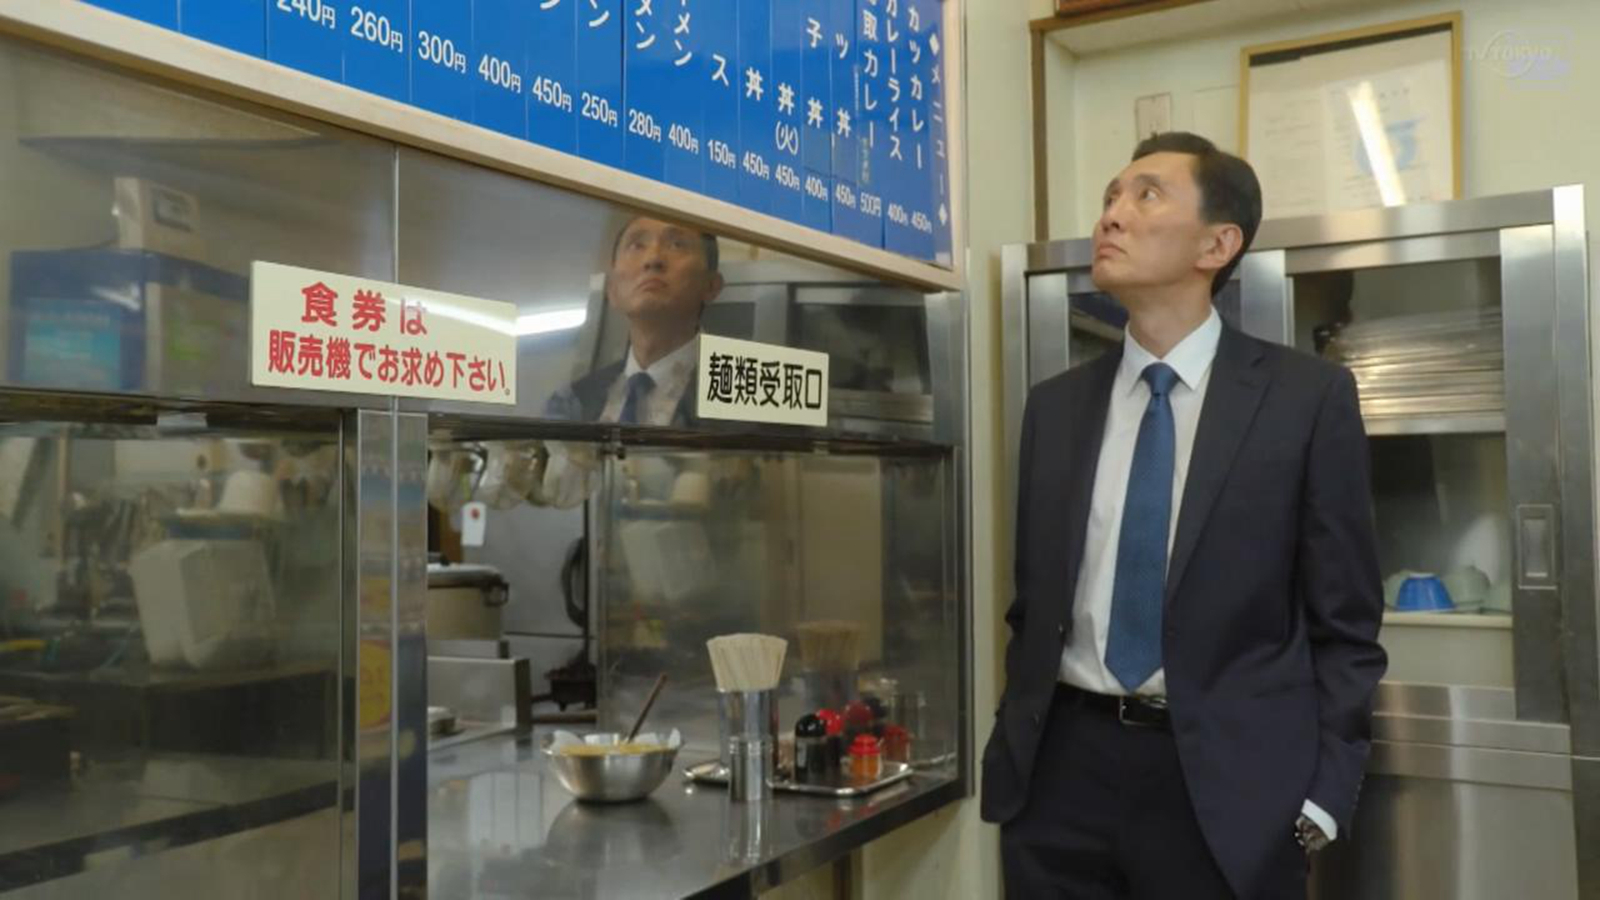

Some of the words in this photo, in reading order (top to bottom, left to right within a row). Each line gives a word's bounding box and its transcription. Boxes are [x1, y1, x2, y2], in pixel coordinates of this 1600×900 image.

[350, 6, 403, 53] 260円
[674, 0, 693, 67] メン
[418, 30, 467, 75] 300円
[478, 54, 521, 95] 400円
[712, 53, 730, 87] ス
[863, 0, 879, 148] 取カレー
[532, 75, 573, 113] 450円
[581, 92, 618, 128] 250円
[628, 108, 661, 143] 280円
[668, 123, 699, 155] 400円
[707, 139, 736, 170] 150円
[742, 151, 770, 181] 450円
[775, 163, 801, 191] 450円
[804, 175, 829, 202] 400円
[834, 183, 857, 210] 450円
[860, 191, 882, 218] 500円
[887, 202, 909, 227] 400円
[911, 211, 933, 234] 450円
[268, 335, 511, 396] 販売機でお求め下さい。
